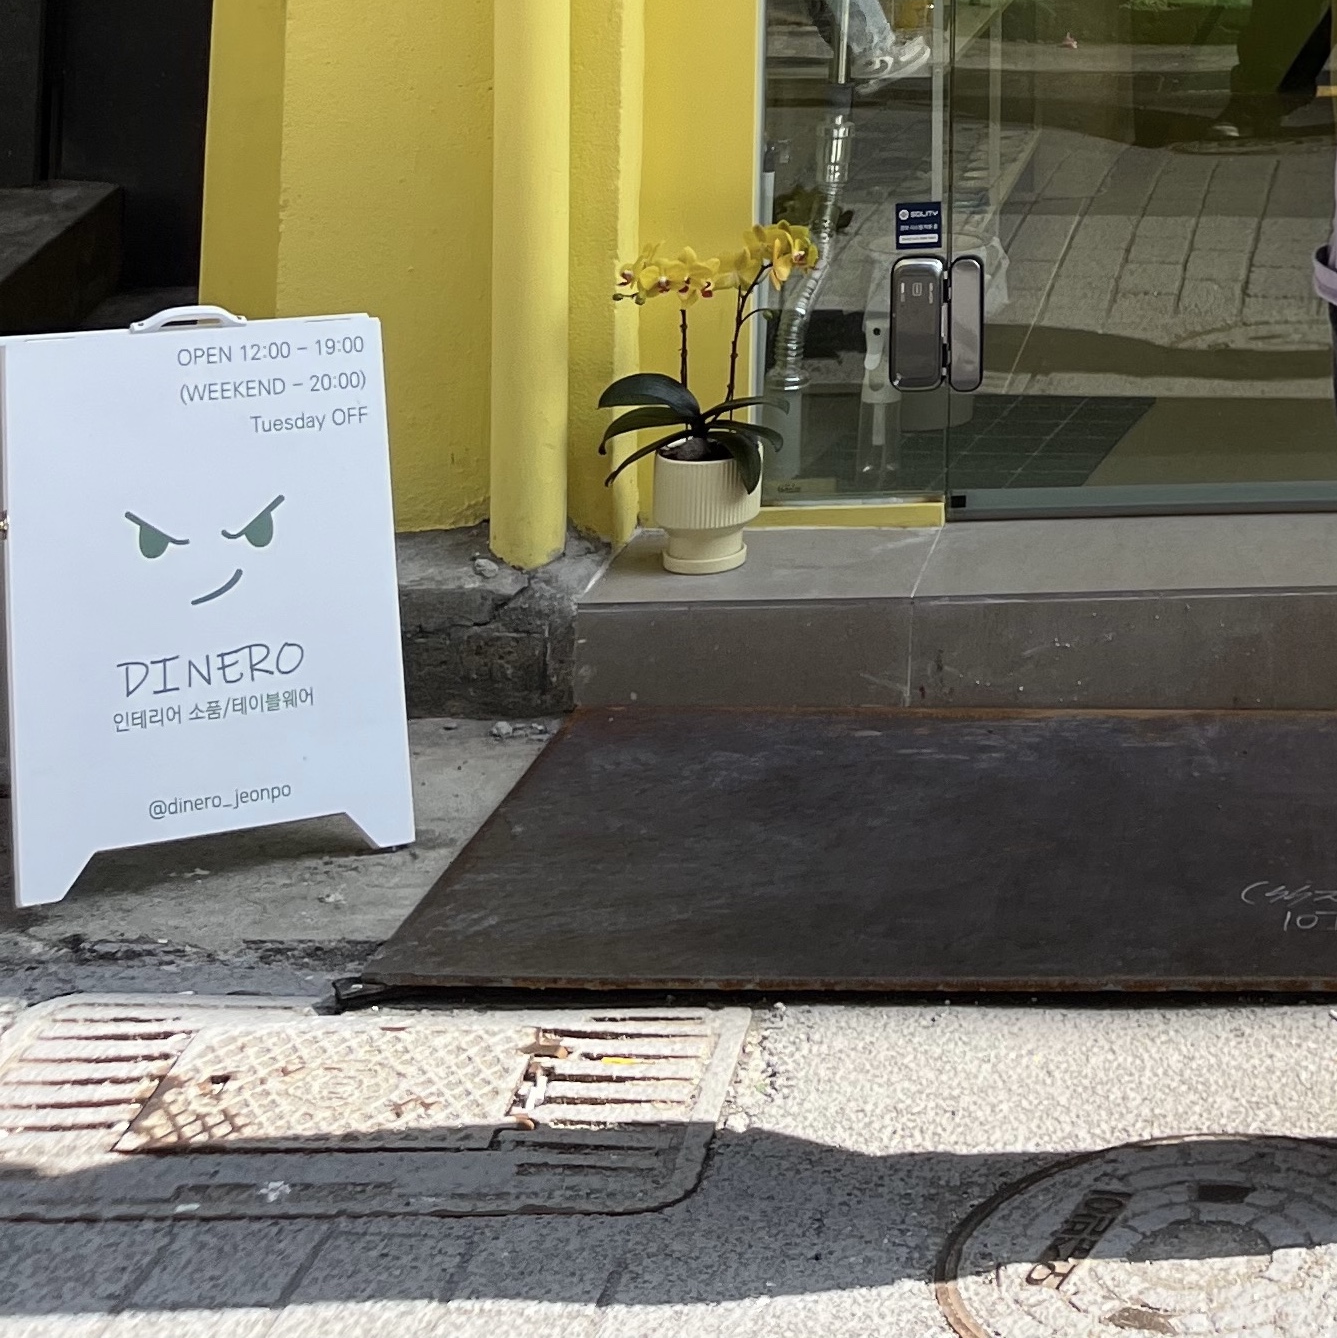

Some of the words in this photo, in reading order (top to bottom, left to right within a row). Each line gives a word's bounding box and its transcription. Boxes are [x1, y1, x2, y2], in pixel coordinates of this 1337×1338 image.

[177, 346, 232, 367] OPEN
[240, 342, 290, 362] 12:00
[314, 336, 364, 356] 19:00
[180, 378, 286, 405] (WEEKEND
[310, 370, 366, 393] 20:00)
[250, 412, 326, 434] Tuesday
[332, 406, 367, 426] OFF
[117, 642, 305, 700] DINERO
[113, 704, 182, 733] 인테리어
[189, 686, 314, 720] 소품/테이블웨어
[149, 784, 292, 822] @dinero_jeonpo
